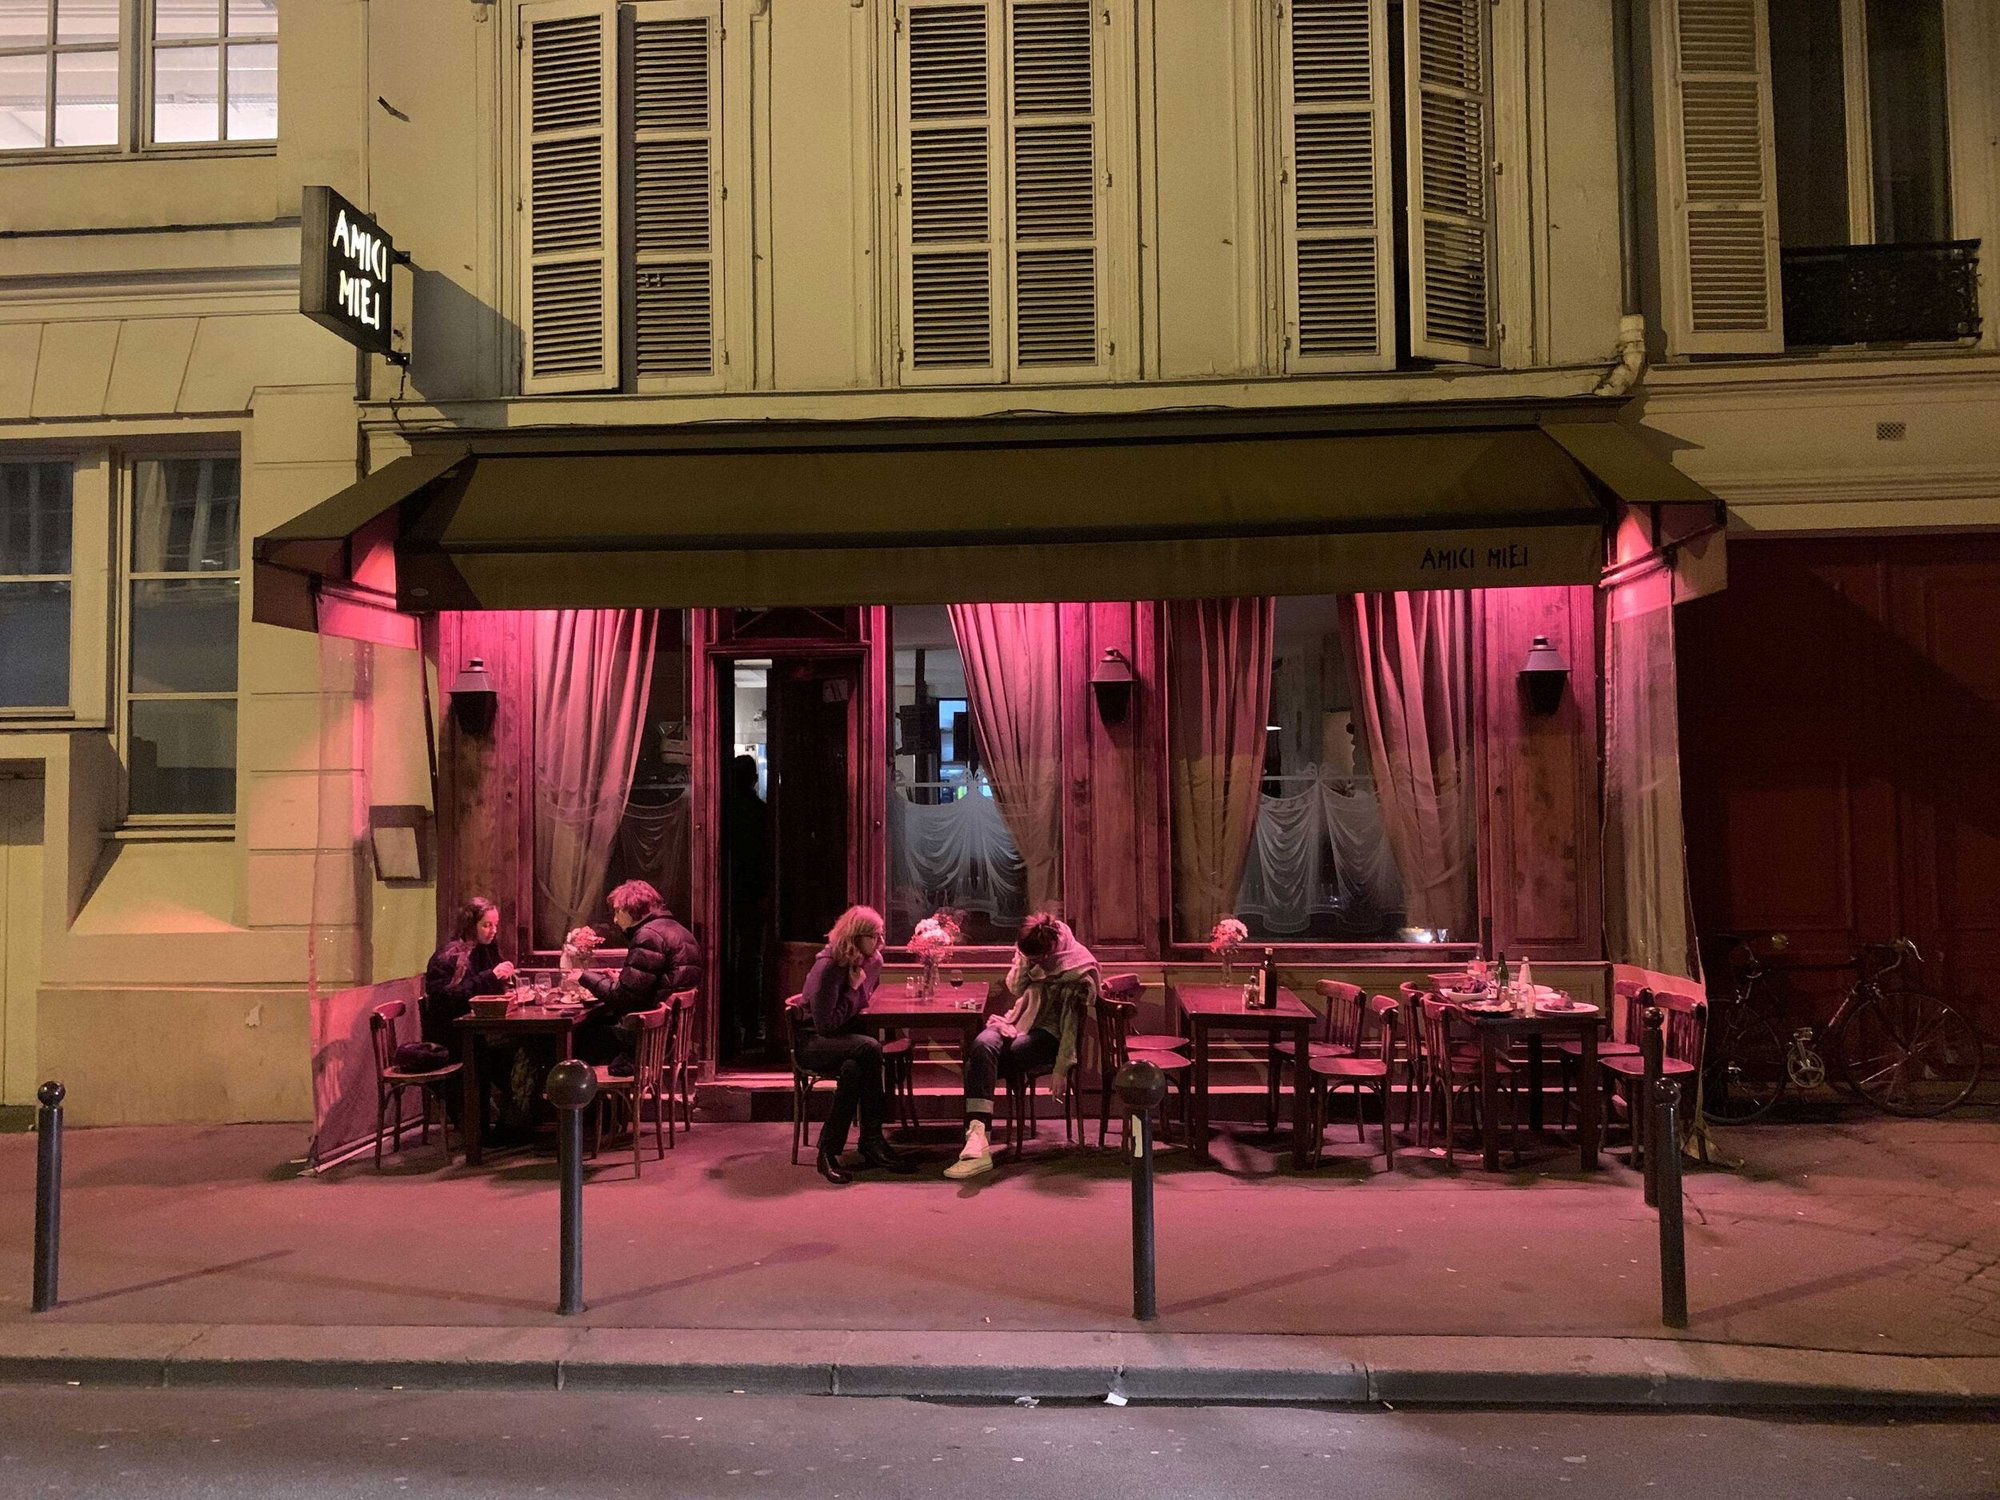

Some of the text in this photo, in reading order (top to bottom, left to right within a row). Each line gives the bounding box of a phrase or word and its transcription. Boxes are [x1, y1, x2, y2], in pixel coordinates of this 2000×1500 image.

[332, 209, 387, 283] AMICI
[339, 269, 380, 331] MIEI
[1420, 544, 1528, 571] AMICI MIEI
